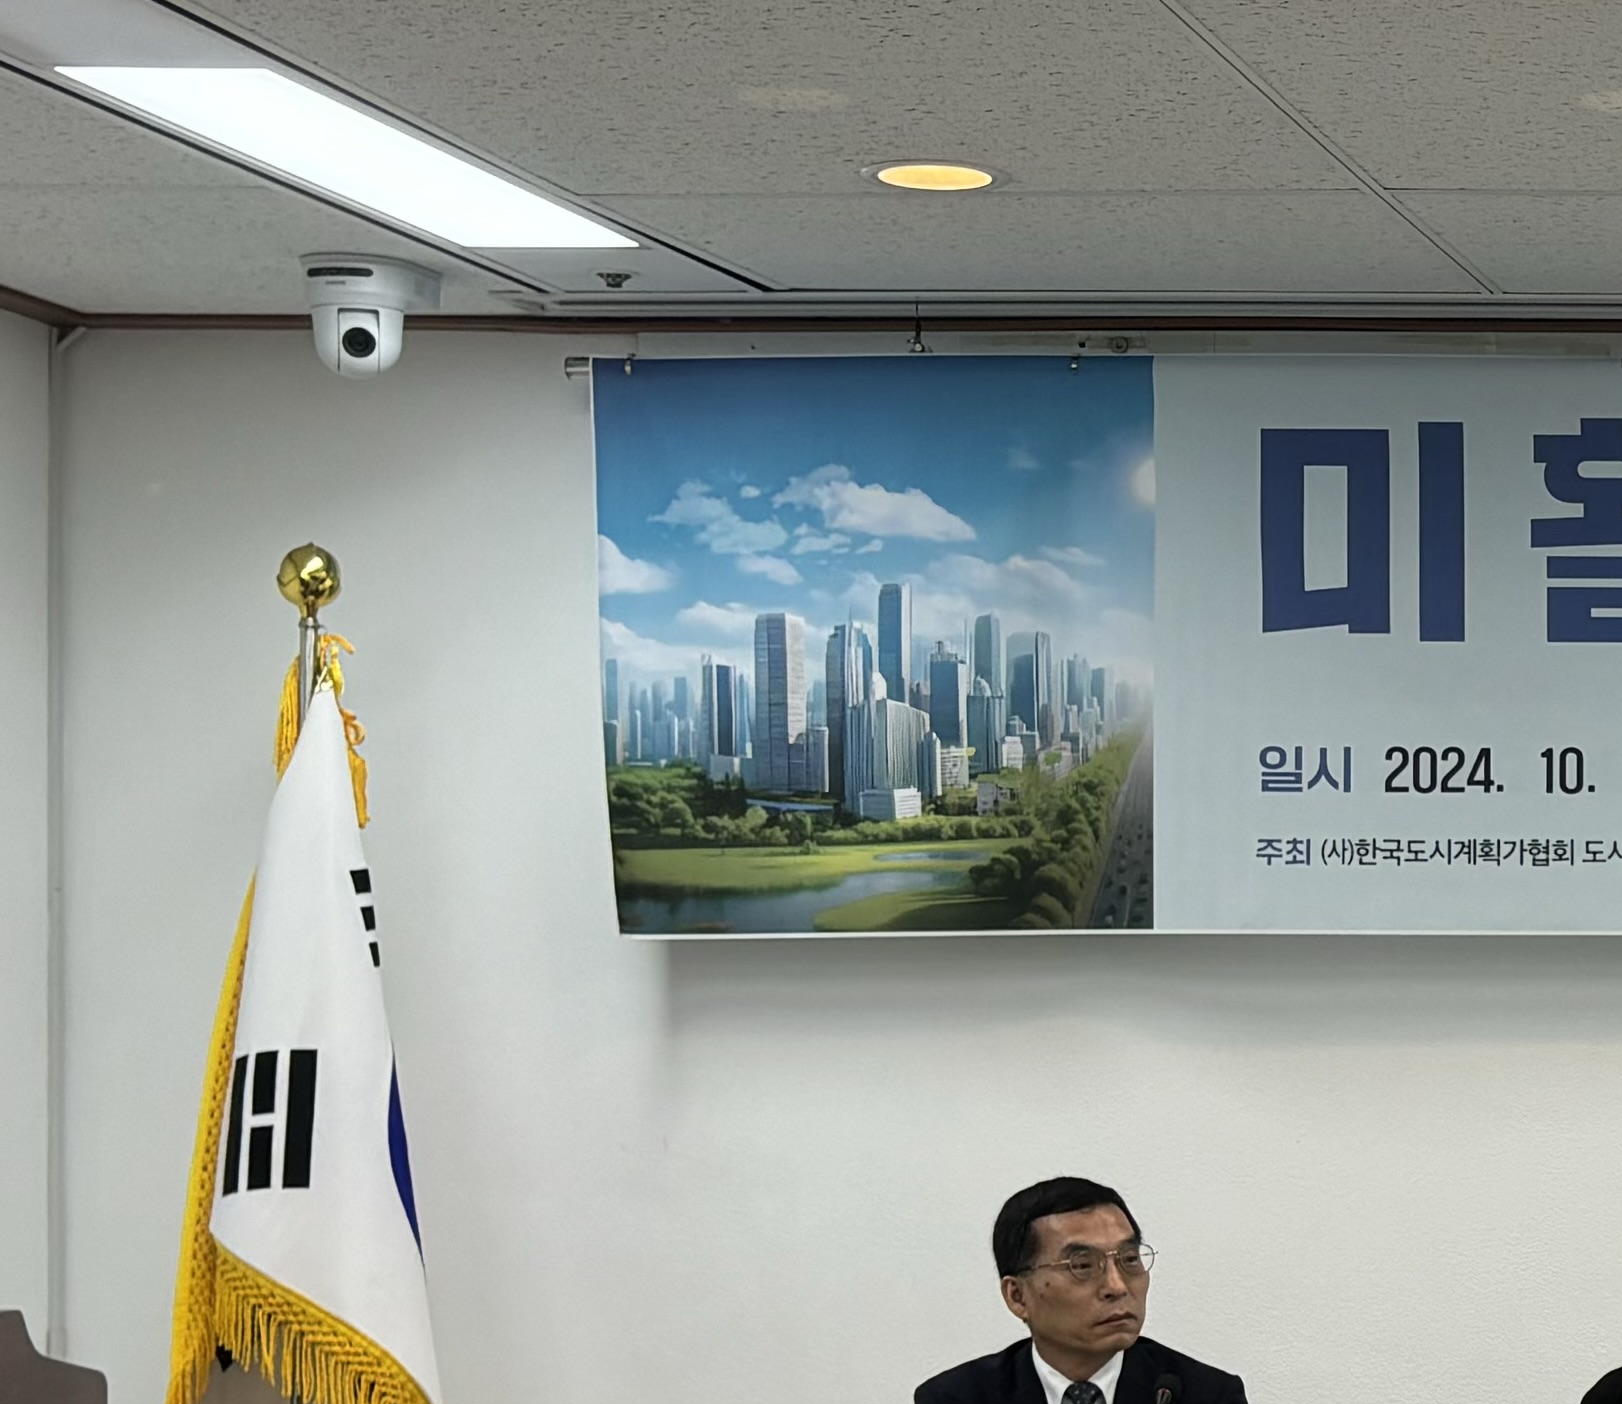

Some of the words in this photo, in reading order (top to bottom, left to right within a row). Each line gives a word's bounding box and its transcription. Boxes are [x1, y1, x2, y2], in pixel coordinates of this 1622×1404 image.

[1259, 745, 1352, 793] 일시
[1384, 746, 1504, 794] 2024.
[1540, 746, 1596, 795] 10.
[1255, 837, 1311, 866] 주최
[1321, 837, 1575, 867] (사)한국도시계획가협회
